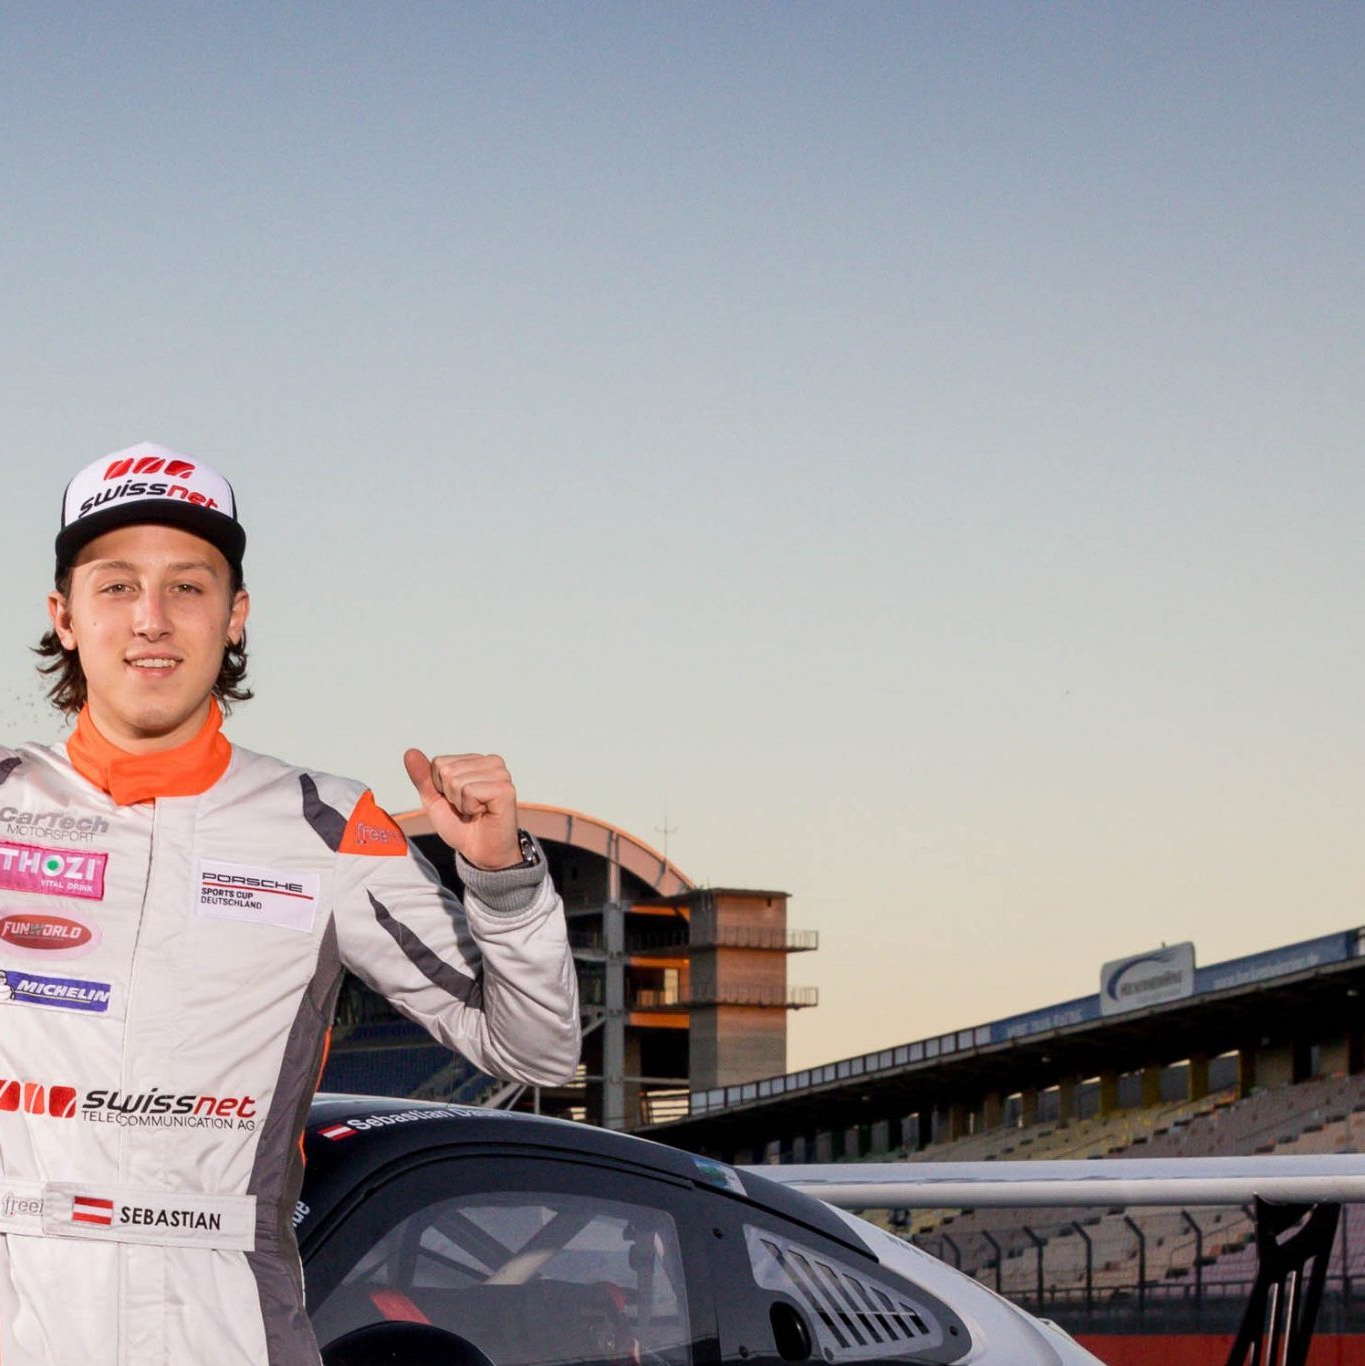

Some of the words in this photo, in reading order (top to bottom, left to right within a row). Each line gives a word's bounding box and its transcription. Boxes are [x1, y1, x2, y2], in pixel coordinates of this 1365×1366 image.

[78, 480, 218, 517] swissnet
[6, 823, 96, 843] MOTORSPORT
[40, 879, 63, 889] VITAL
[67, 882, 93, 893] DRINK
[201, 872, 303, 893] PORSCHE
[200, 896, 262, 910] DEUTSCHLAND
[201, 888, 234, 898] SPORTS
[236, 891, 253, 900] CUP
[1, 921, 82, 939] FUNWORLD
[16, 980, 110, 1003] MICHELIN
[82, 1088, 257, 1118] swissnet
[237, 1117, 256, 1131] AG
[346, 1110, 454, 1131] Sebastian
[120, 1206, 221, 1231] SEBASTIAN
